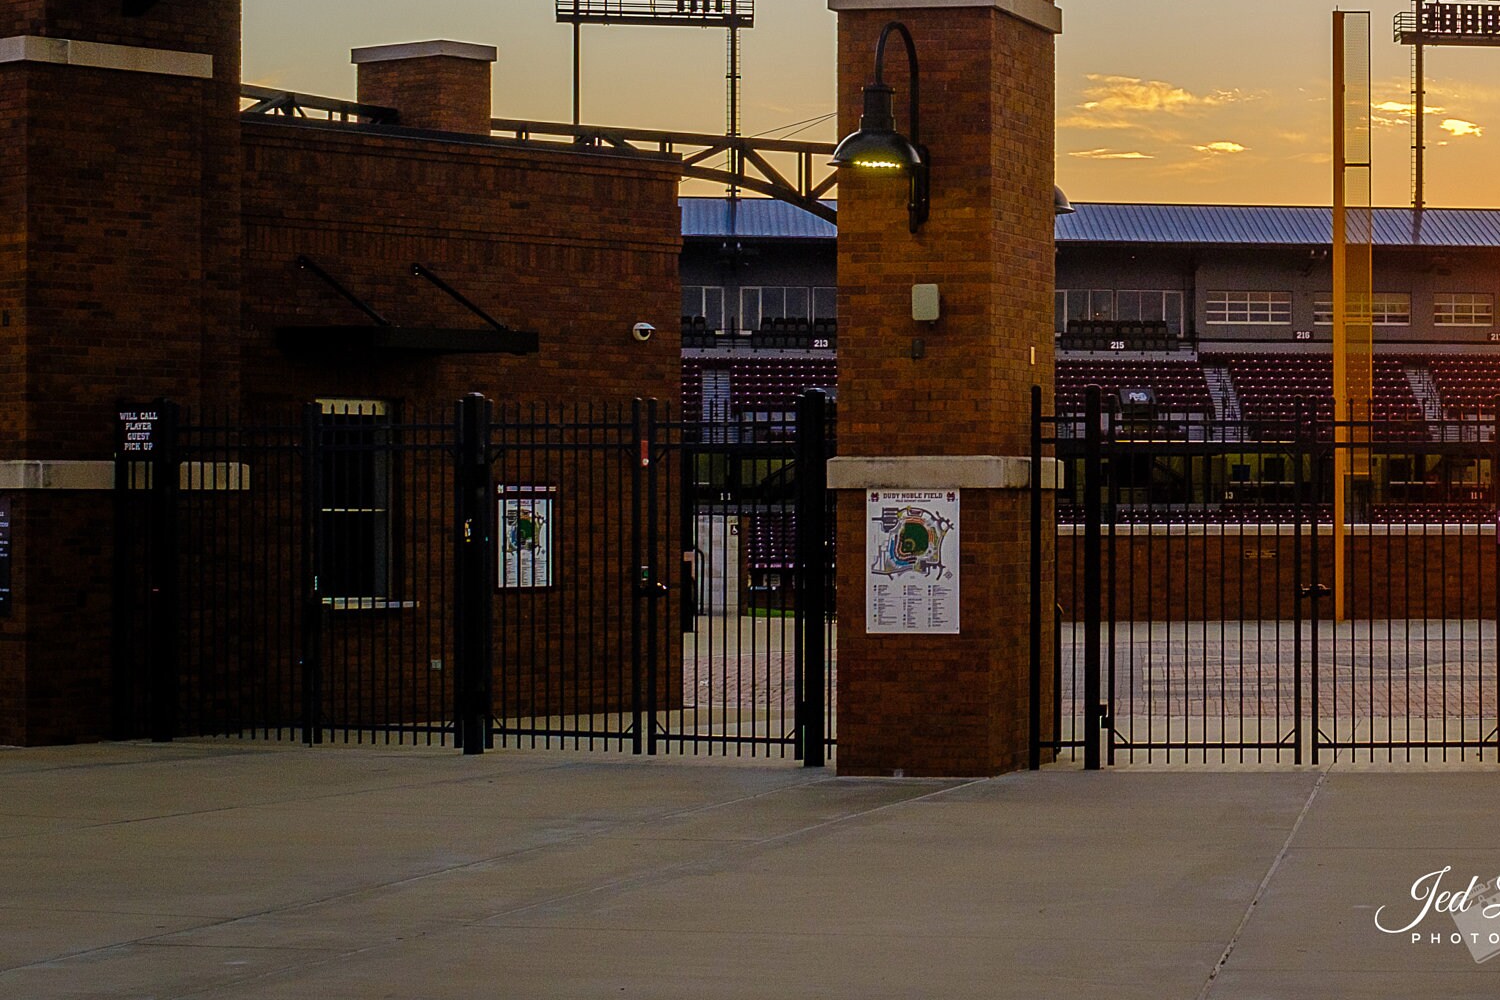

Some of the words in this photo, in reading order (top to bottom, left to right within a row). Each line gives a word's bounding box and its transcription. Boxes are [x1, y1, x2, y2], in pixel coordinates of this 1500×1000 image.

[1296, 331, 1310, 339] 216
[814, 339, 829, 348] 213
[1110, 341, 1125, 349] 215
[120, 412, 138, 420] WILL
[140, 412, 158, 420] CALL
[125, 422, 152, 430] PLAYER
[127, 432, 150, 440] GUEST
[124, 442, 141, 450] PICK
[143, 442, 153, 450] UP
